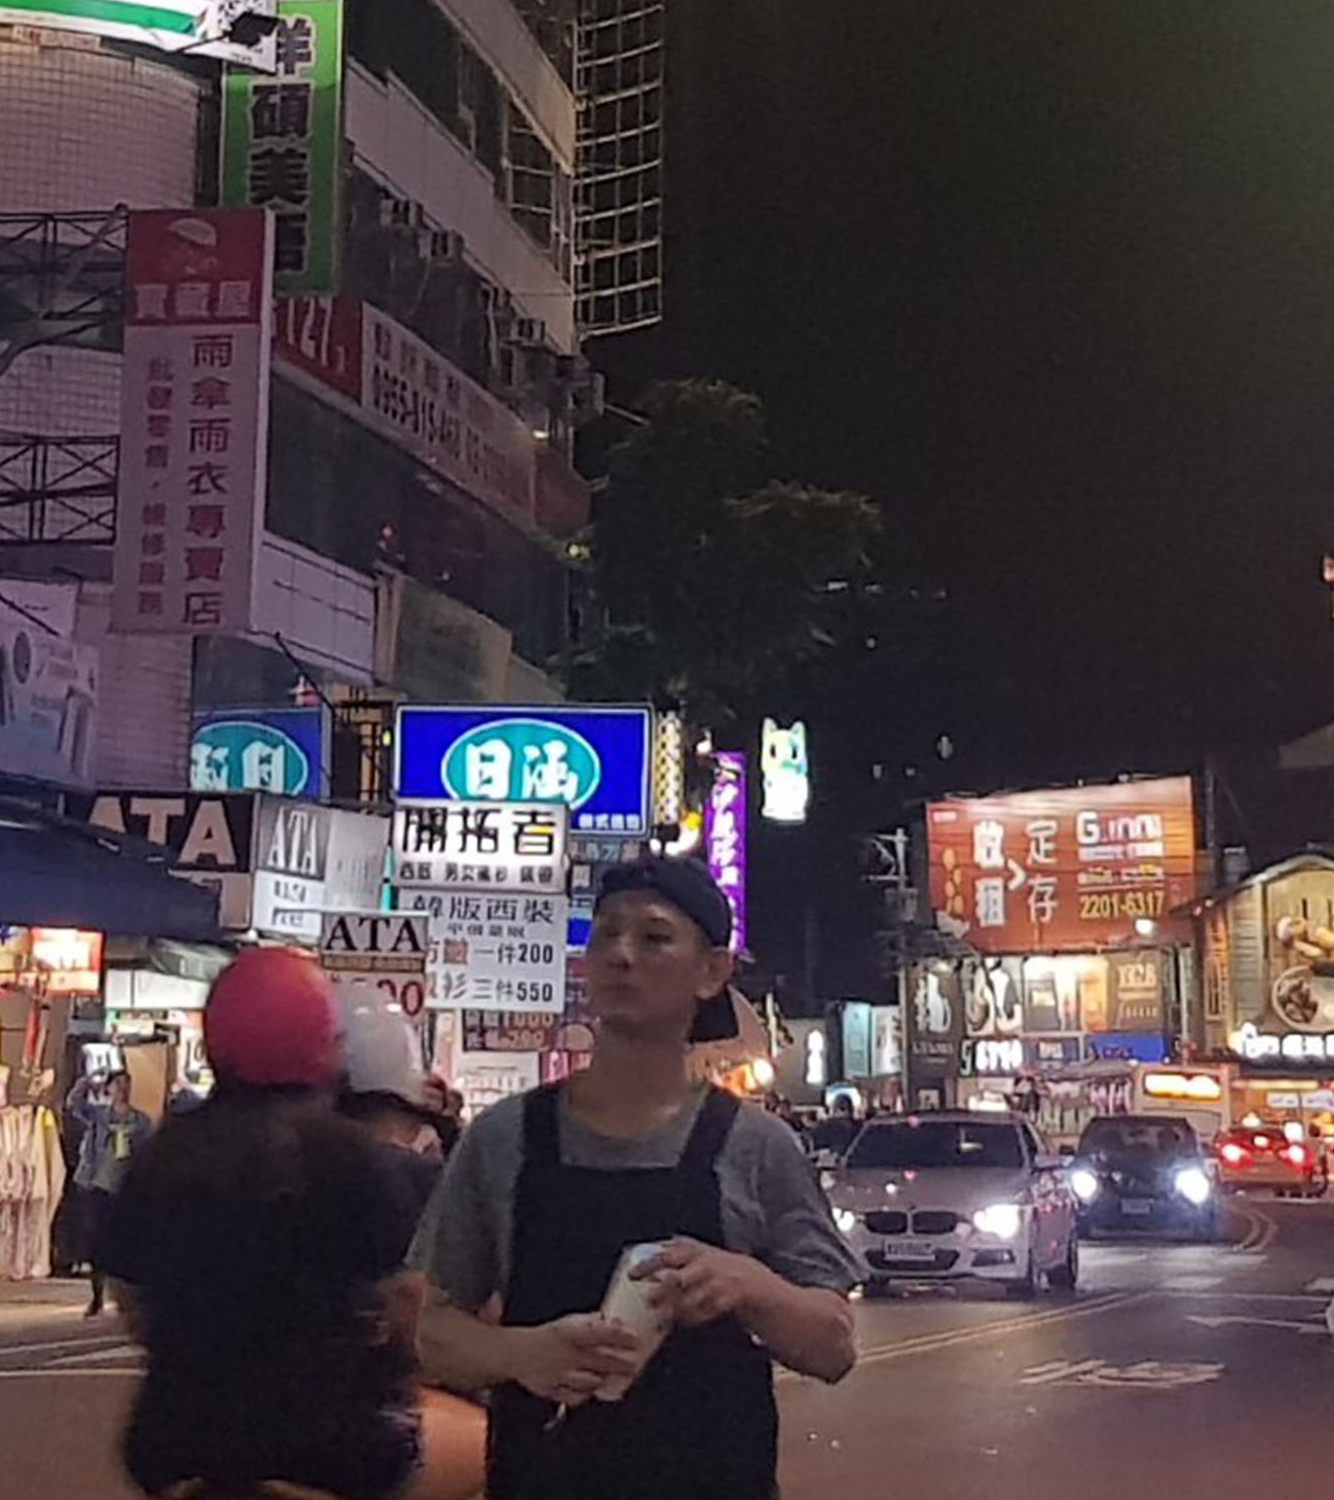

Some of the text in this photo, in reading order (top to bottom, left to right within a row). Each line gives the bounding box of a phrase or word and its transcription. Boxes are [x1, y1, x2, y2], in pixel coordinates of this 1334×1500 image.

[181, 333, 235, 626] 雨傘雨衣專賣店
[267, 806, 318, 876] ATA
[325, 914, 423, 952] ATA
